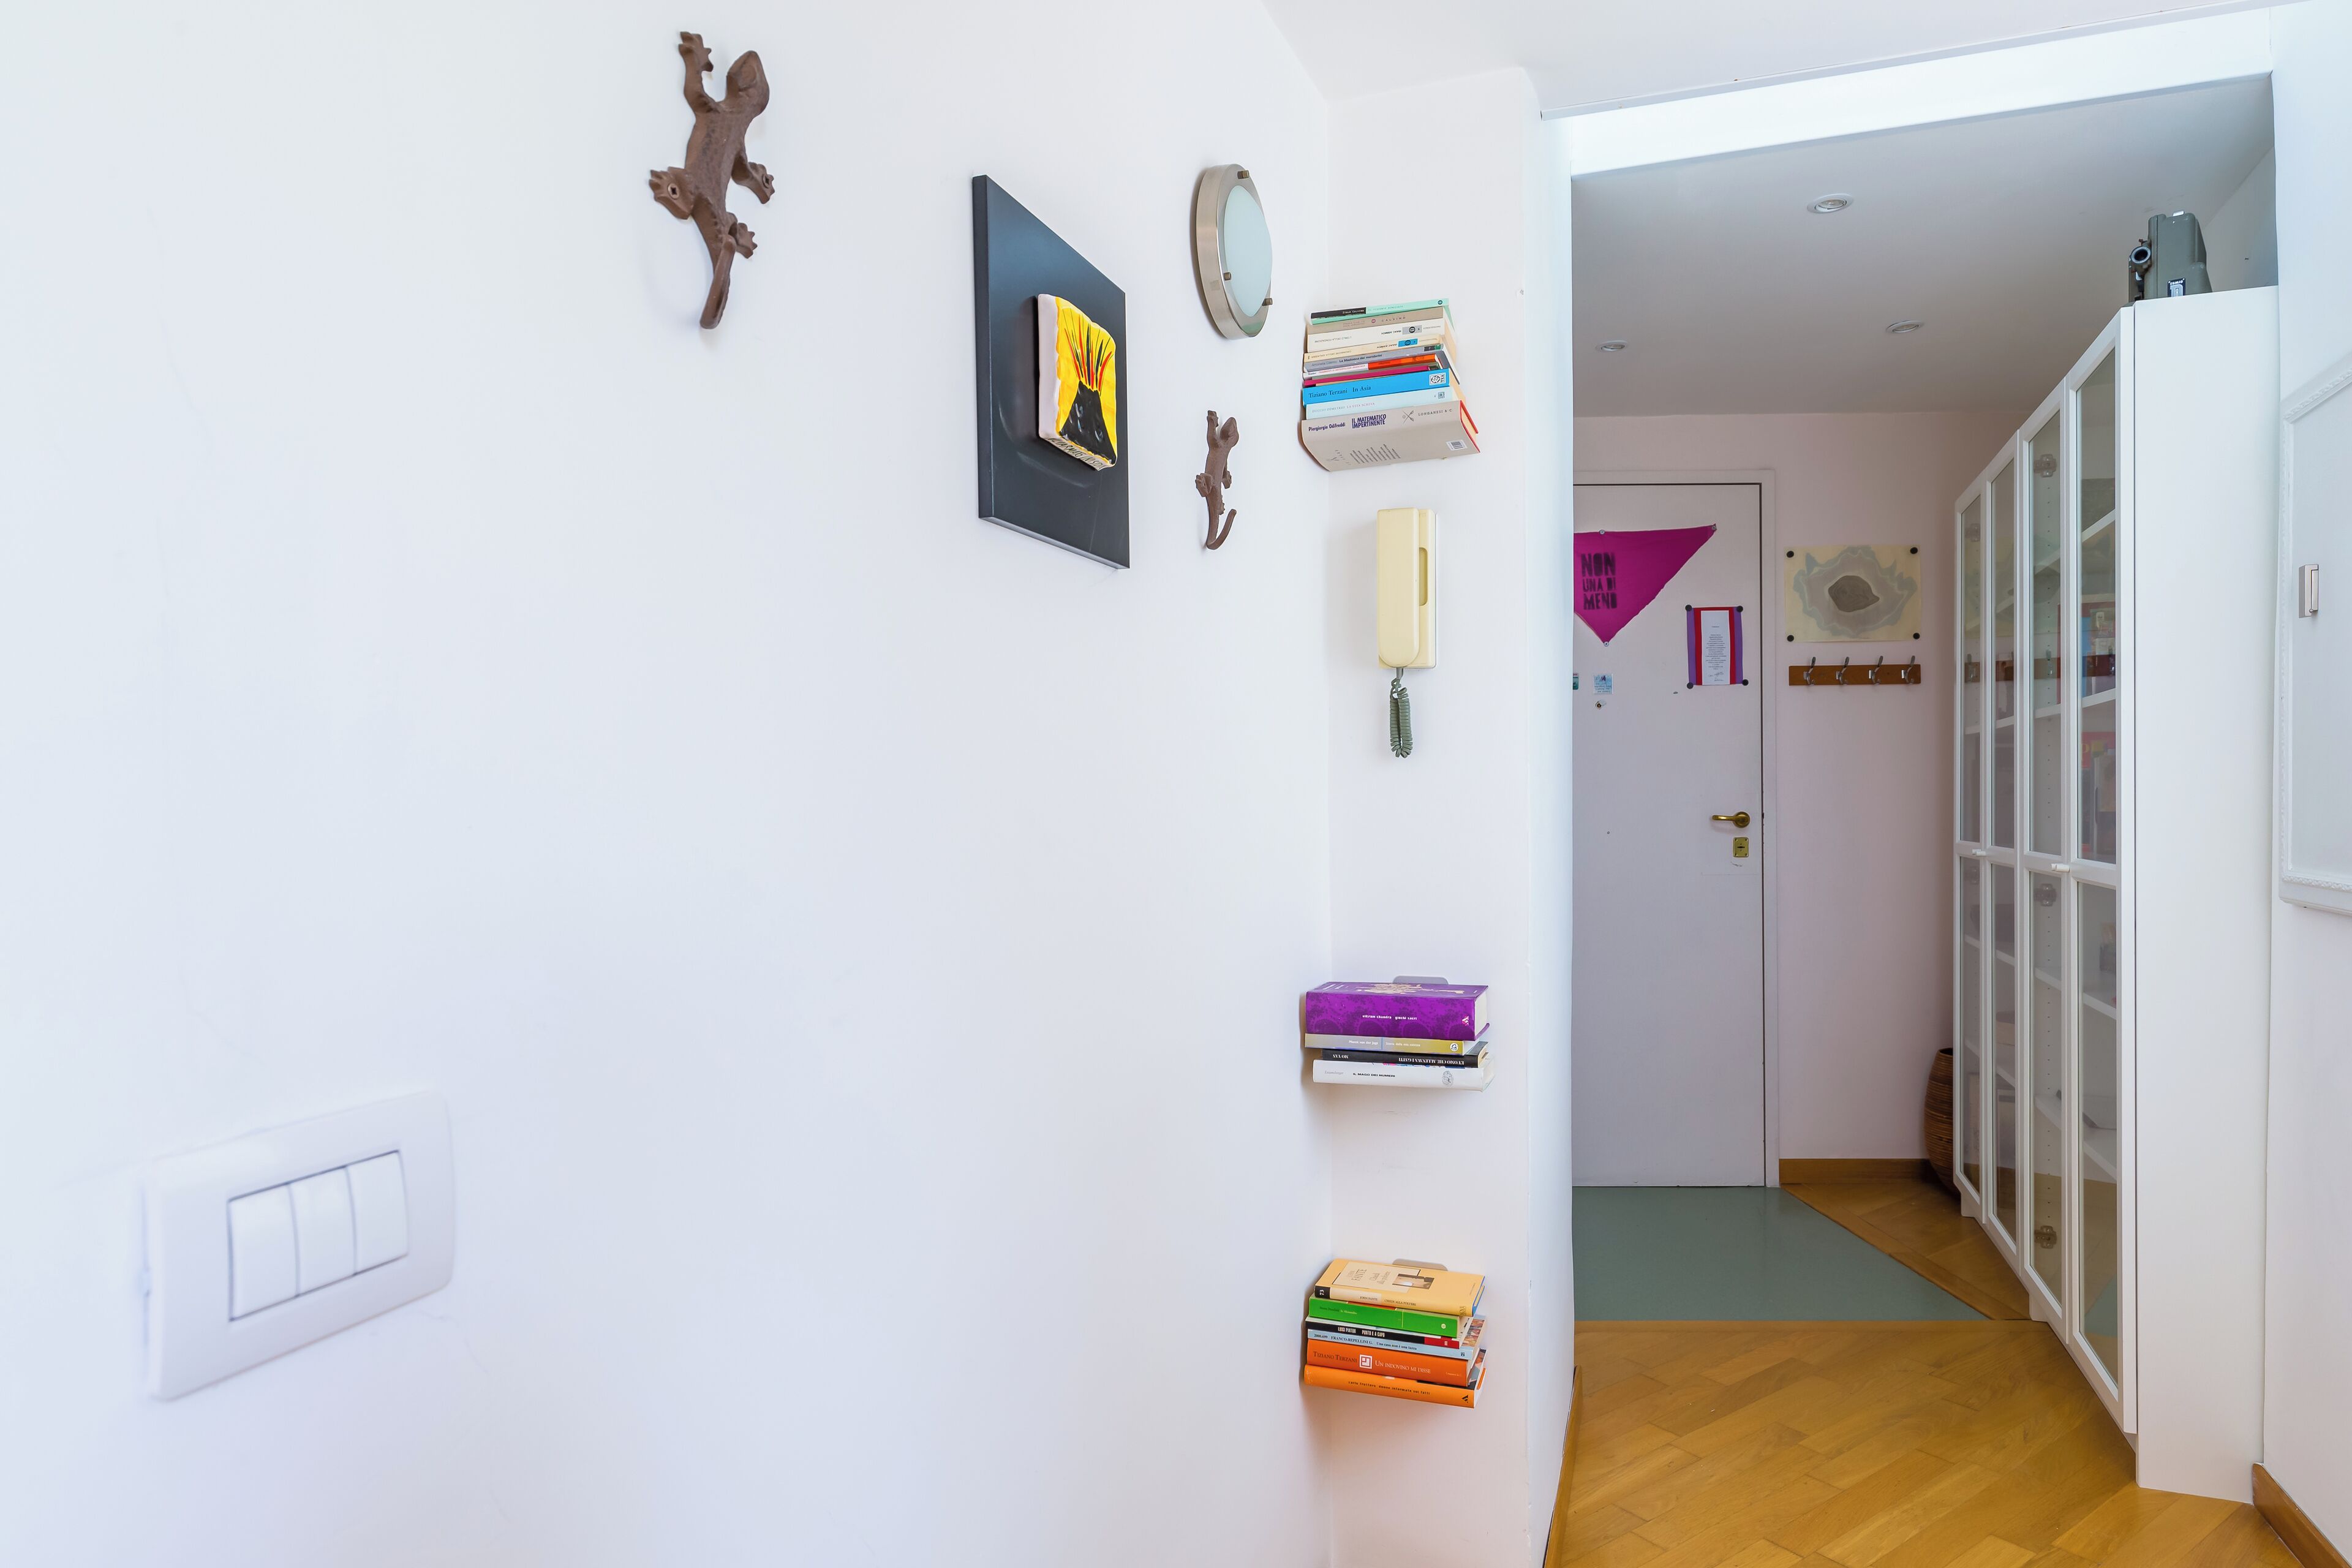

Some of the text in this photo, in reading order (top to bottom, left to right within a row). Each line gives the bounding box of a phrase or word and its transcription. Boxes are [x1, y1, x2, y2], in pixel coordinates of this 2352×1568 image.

[1352, 419, 1385, 429] IMPERTINENTE
[1357, 414, 1386, 423] MATEMATICO
[1581, 552, 1616, 577] NON
[1583, 577, 1616, 592] UNA DI
[1583, 592, 1618, 610] MENO
